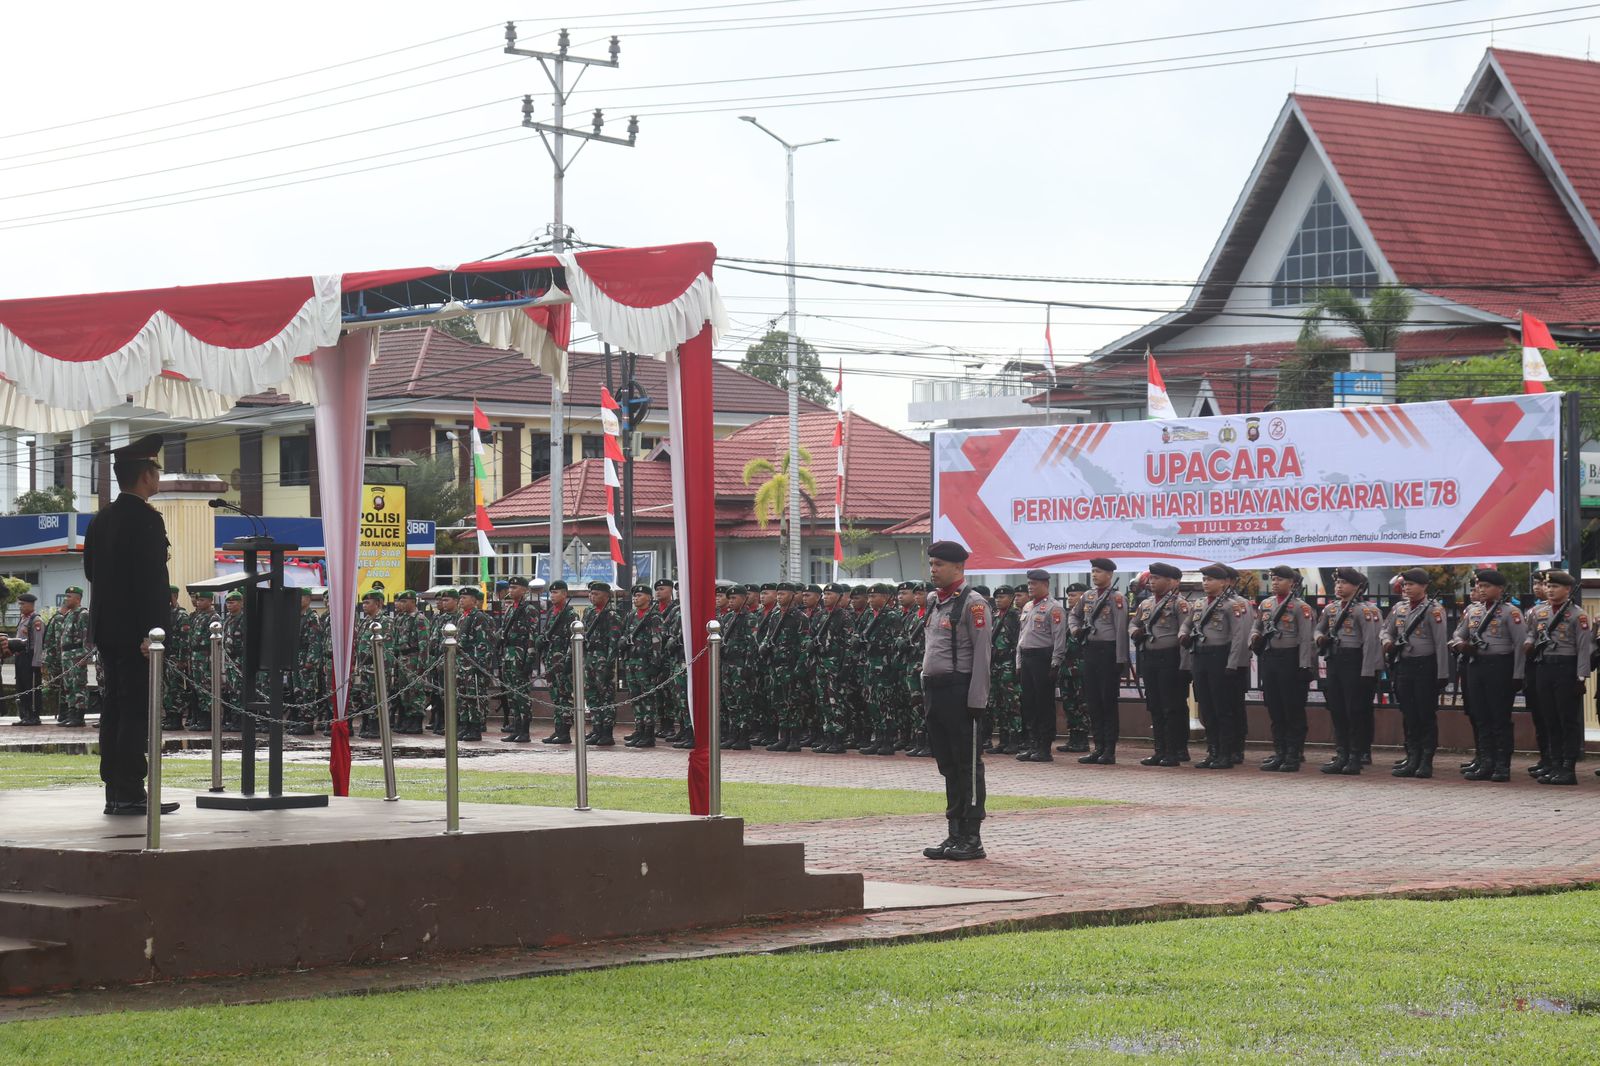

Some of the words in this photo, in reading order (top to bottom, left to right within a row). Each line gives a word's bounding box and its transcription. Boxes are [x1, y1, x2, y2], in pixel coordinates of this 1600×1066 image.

[1145, 446, 1303, 485] UPACARA
[1013, 494, 1146, 523] PERINGATAN
[1151, 490, 1204, 517] HARI
[1209, 483, 1388, 515] BHAYANGKARA
[1393, 481, 1424, 508] KE
[1429, 480, 1457, 507] 78
[46, 515, 59, 528] BRI
[412, 522, 429, 534] BRI
[1193, 523, 1198, 532] 1
[1203, 521, 1230, 532] JULI
[1236, 521, 1268, 531] 2024
[1068, 541, 1109, 550] mendukung
[1111, 540, 1150, 550] percepatan
[1152, 538, 1196, 548] Transformasi
[1198, 537, 1230, 546] Ekonomi
[1231, 537, 1250, 547] yang
[1251, 534, 1277, 545] Inklusif
[1278, 535, 1293, 543] dan
[1294, 533, 1348, 544] Berkelanjutan
[1349, 533, 1379, 542] menuju
[1380, 531, 1417, 541] Indonesia
